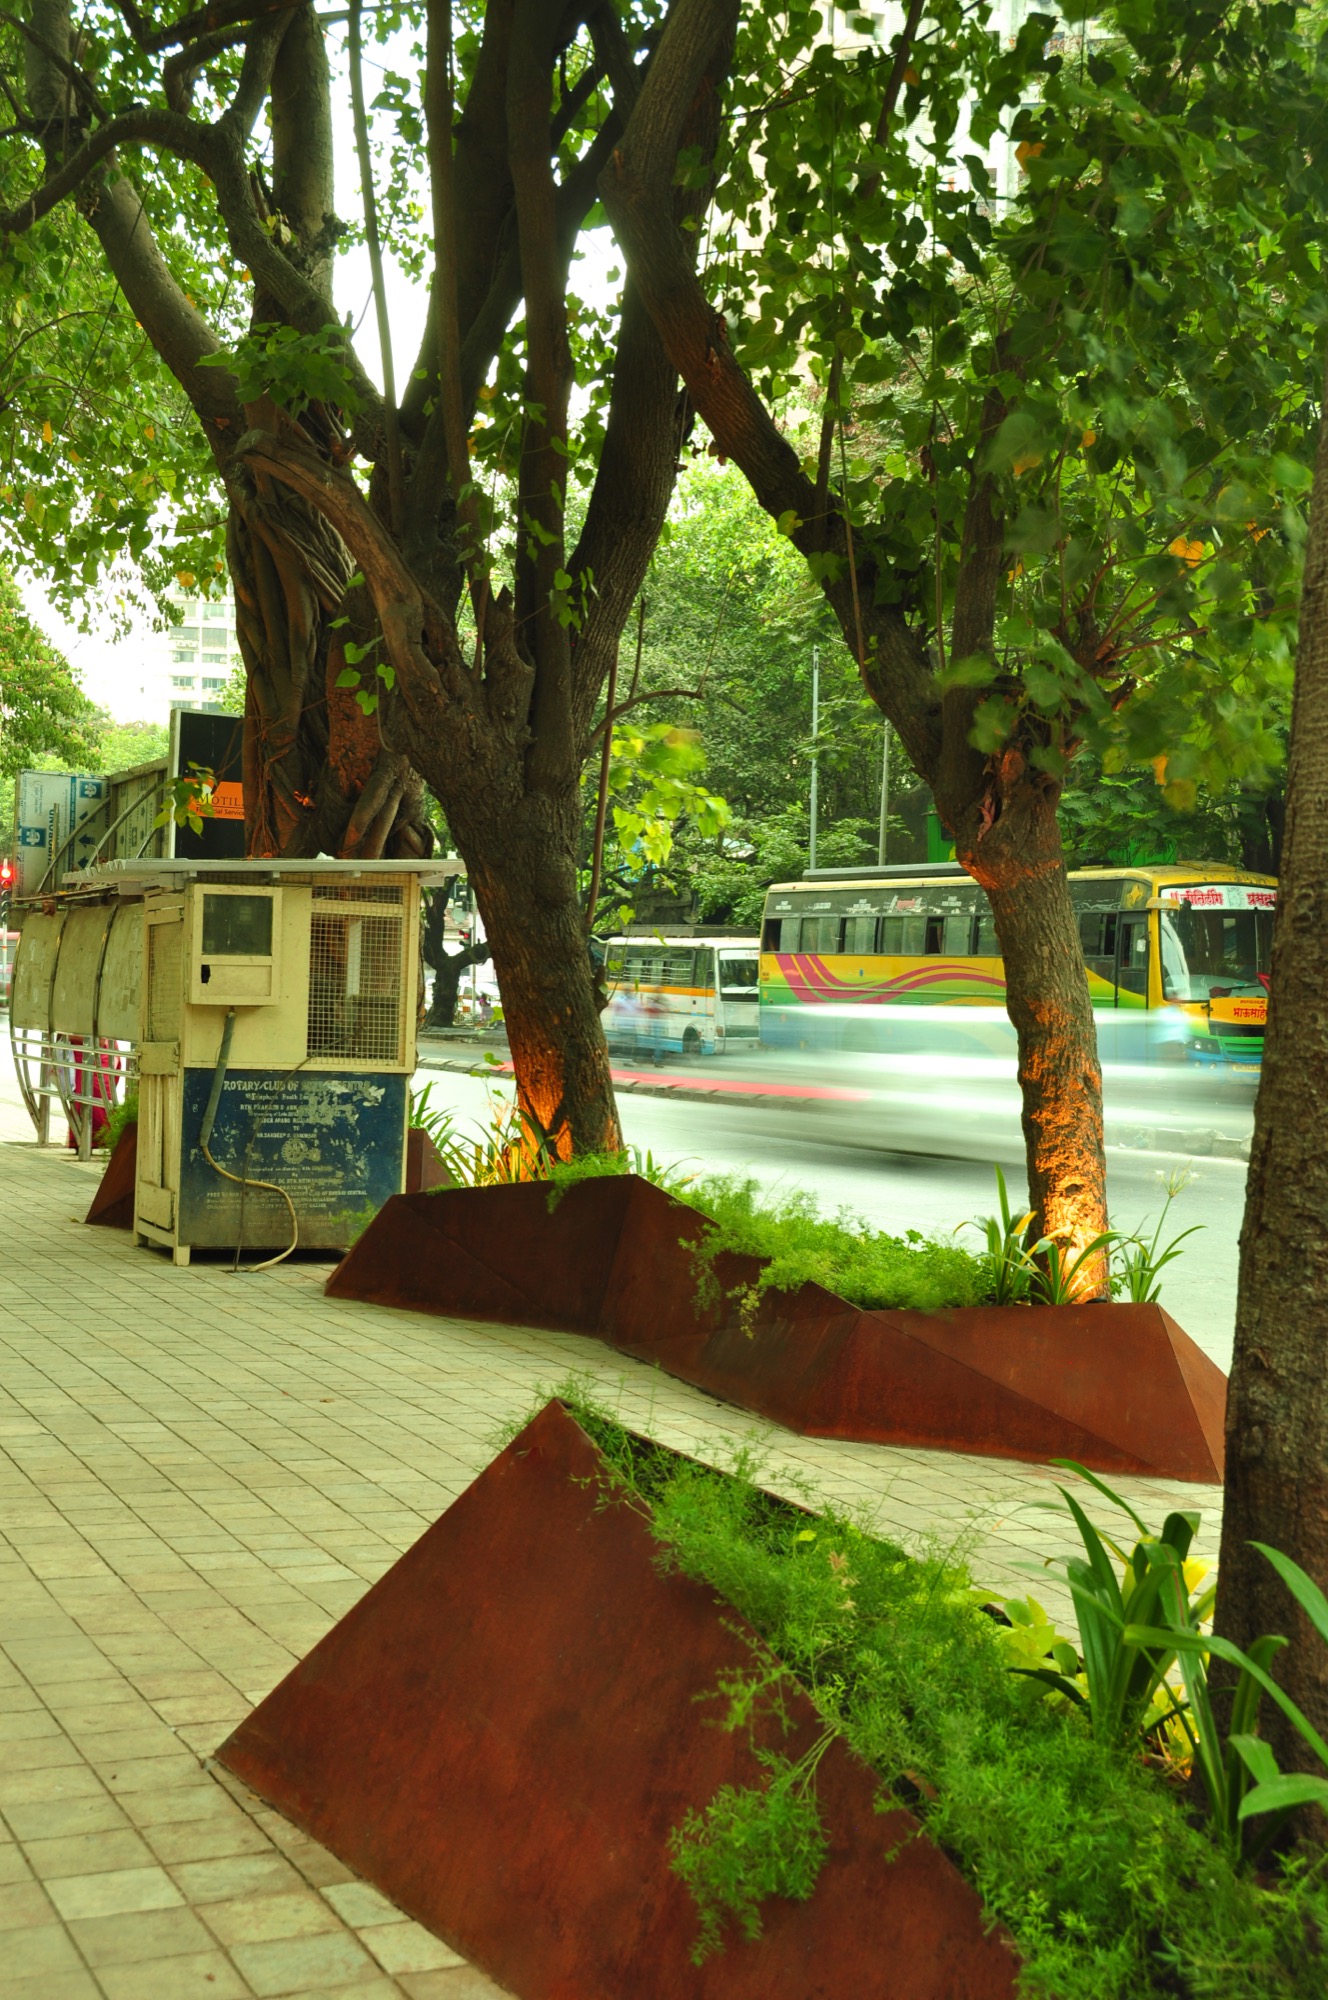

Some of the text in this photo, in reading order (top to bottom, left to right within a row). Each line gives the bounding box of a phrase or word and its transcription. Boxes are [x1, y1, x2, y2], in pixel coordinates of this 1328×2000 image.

[196, 793, 245, 807] MOTIL
[1233, 1005, 1268, 1021] भाऊसाहे
[223, 1080, 261, 1091] ROTARY
[262, 1080, 286, 1091] CLUB
[287, 1080, 300, 1091] OF
